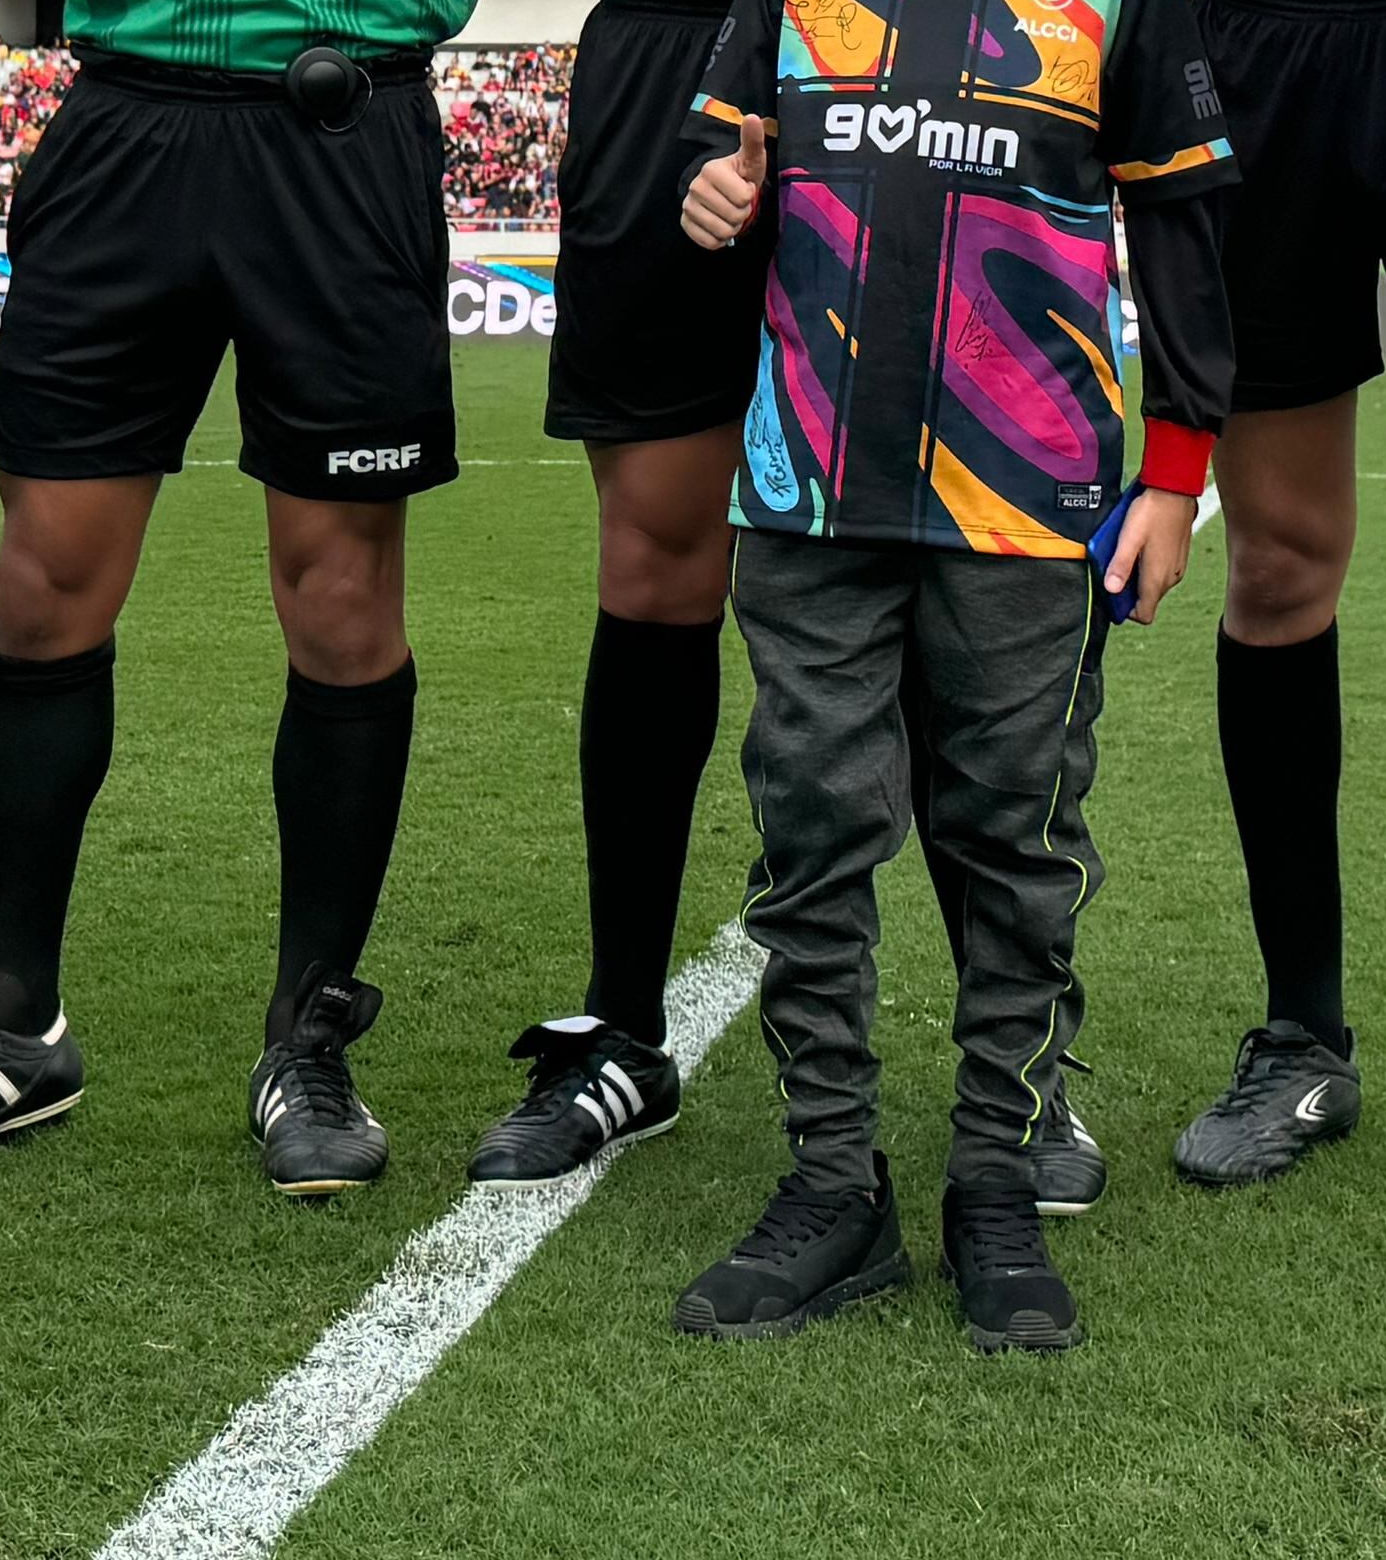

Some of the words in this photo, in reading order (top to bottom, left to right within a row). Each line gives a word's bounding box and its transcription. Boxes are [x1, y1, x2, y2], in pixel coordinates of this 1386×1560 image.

[1014, 17, 1078, 44] ALCCI
[929, 159, 953, 170] POR
[956, 163, 973, 173] LA
[975, 165, 1003, 177] VIDA
